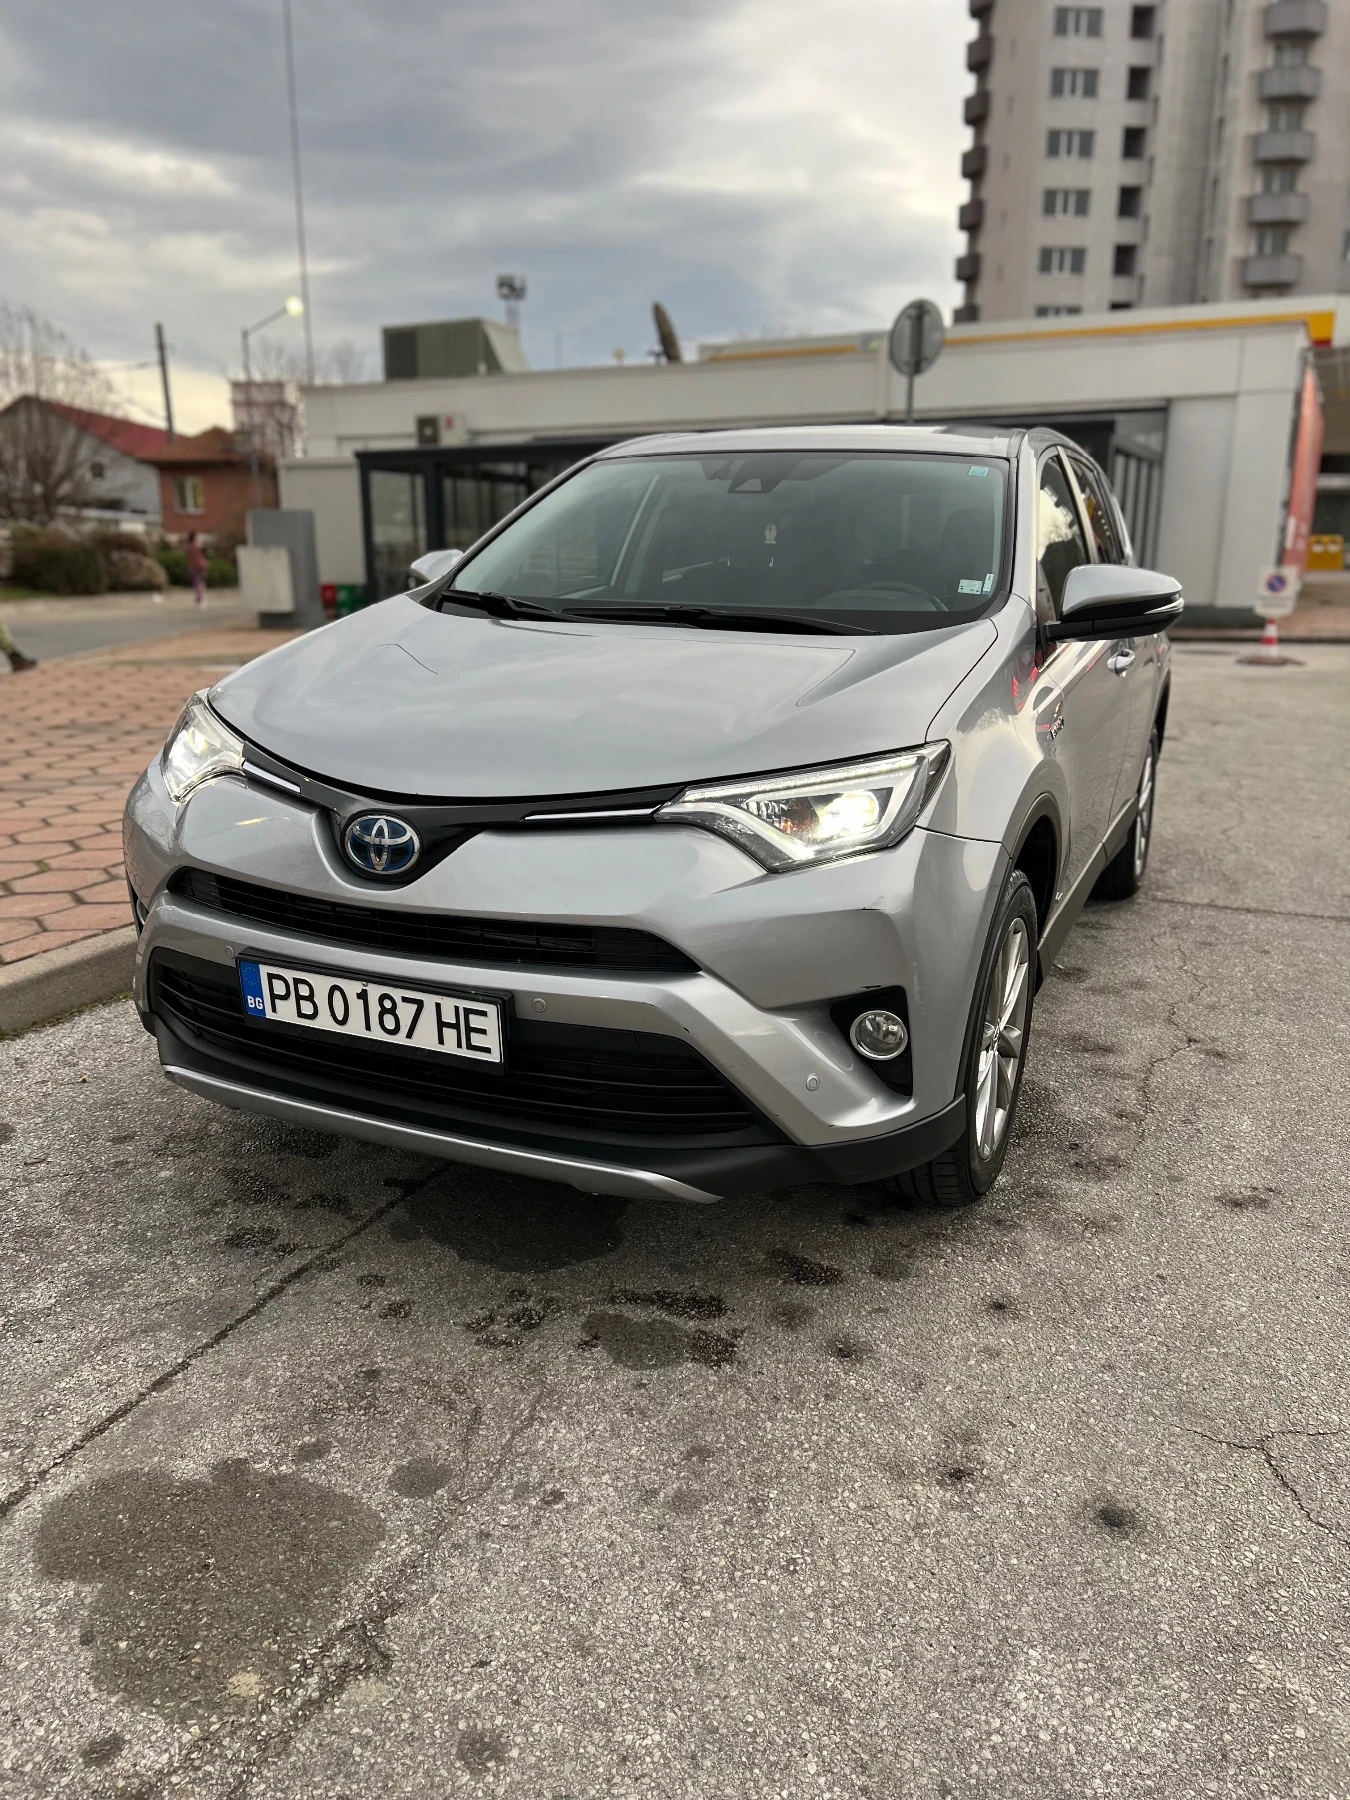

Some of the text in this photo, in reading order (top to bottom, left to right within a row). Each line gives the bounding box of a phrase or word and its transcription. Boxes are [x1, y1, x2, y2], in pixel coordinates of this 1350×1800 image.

[247, 995, 264, 1010] BG
[266, 972, 492, 1054] PB 0187 HE
